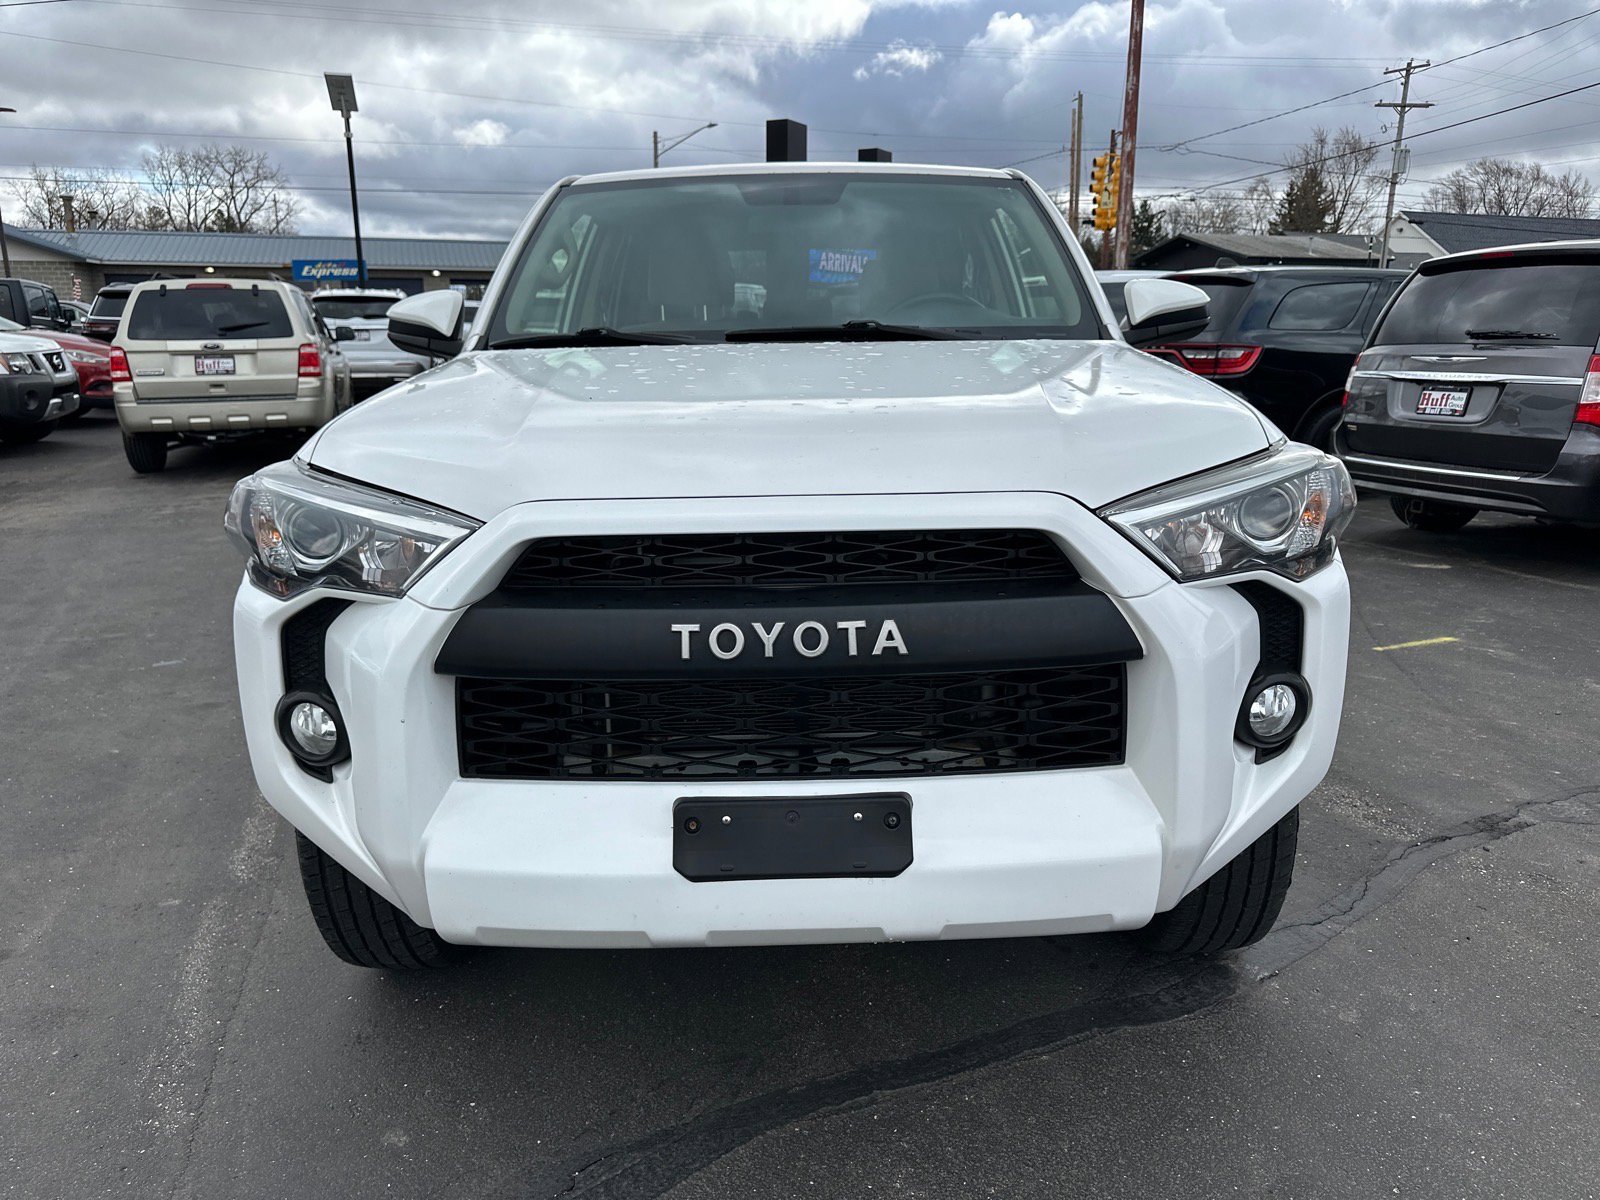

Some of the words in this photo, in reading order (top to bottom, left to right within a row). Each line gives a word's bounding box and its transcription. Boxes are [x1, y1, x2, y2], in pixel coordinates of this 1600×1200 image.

[301, 265, 358, 279] Express
[1420, 392, 1451, 406] Huff
[671, 619, 909, 660] TOYOTA
